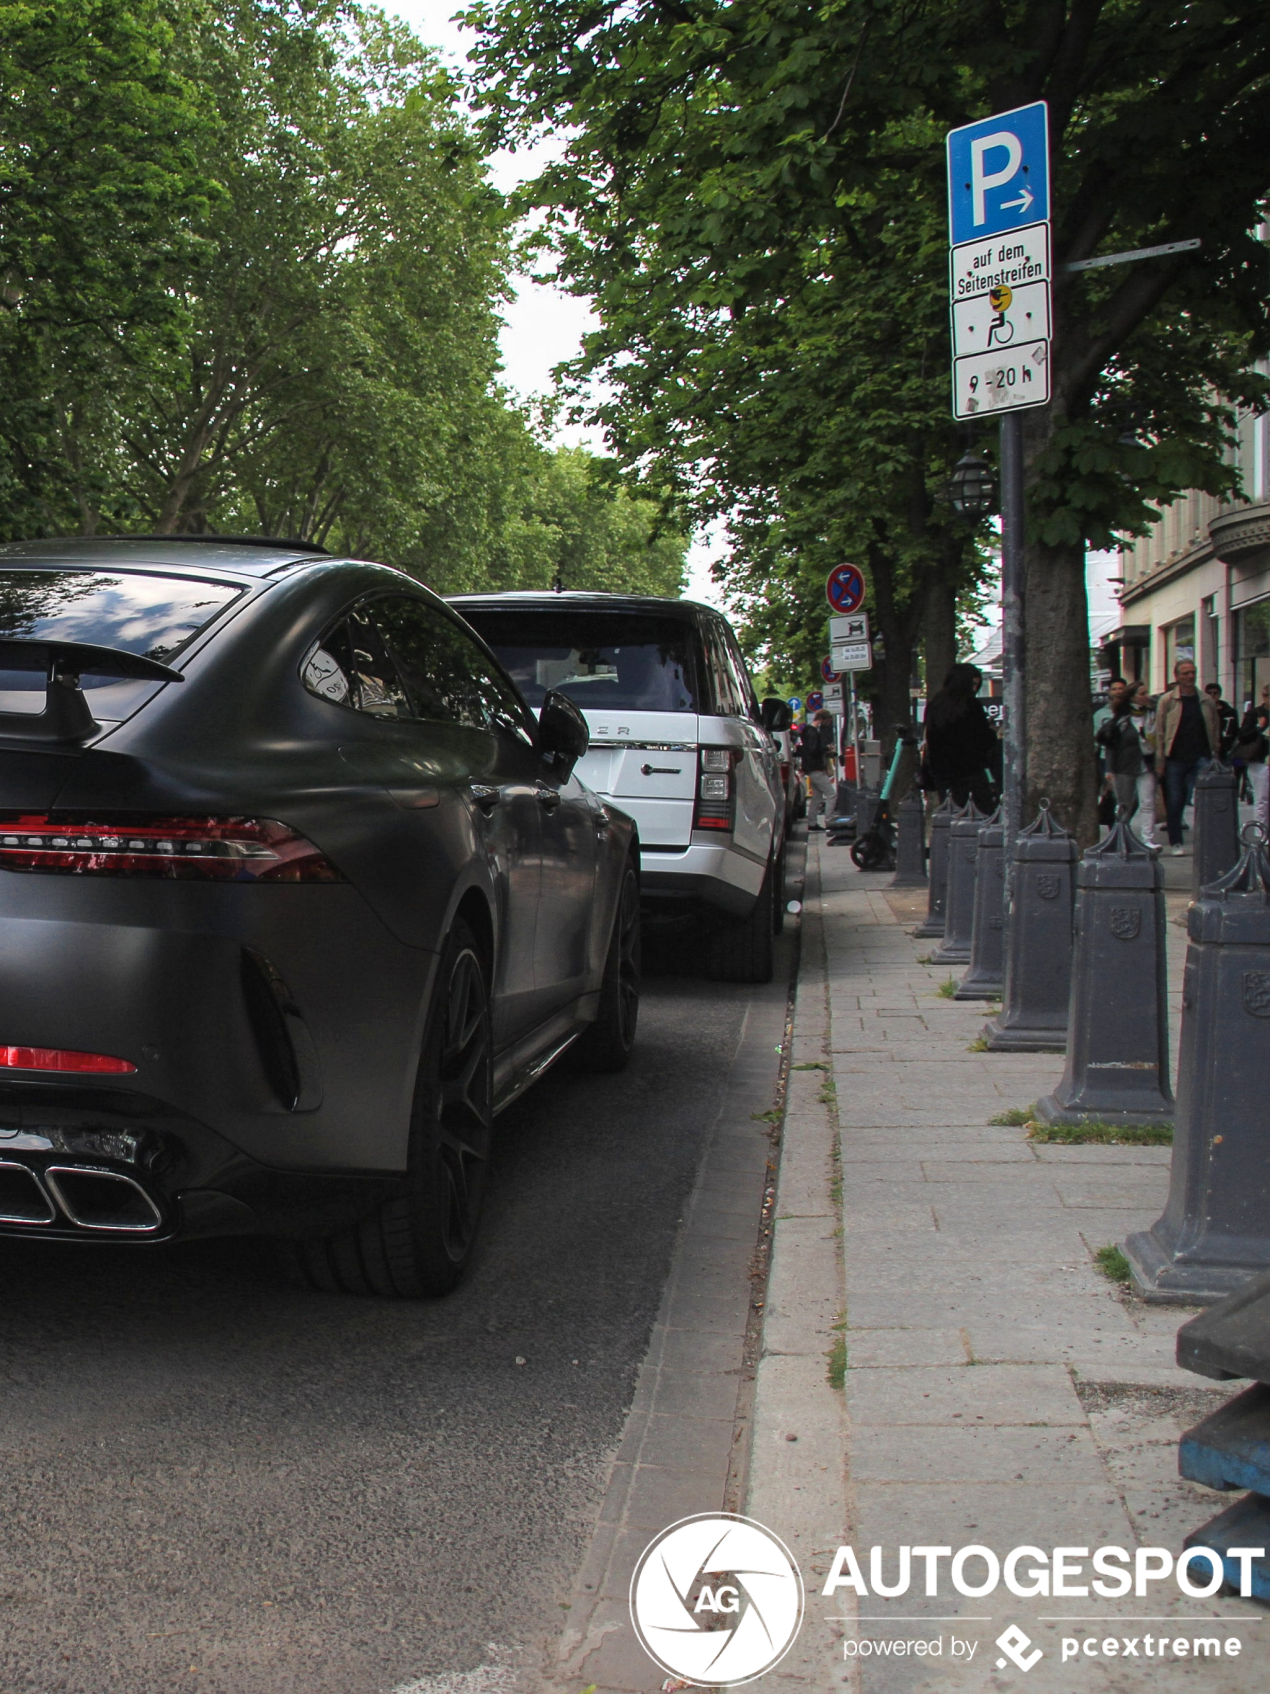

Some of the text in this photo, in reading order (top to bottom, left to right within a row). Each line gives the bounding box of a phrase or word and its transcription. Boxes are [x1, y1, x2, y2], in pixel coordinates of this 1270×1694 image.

[970, 131, 1023, 227] P
[973, 244, 1025, 269] auf dem
[958, 262, 1042, 295] Seitenstreifen
[969, 375, 979, 394] 9
[1022, 364, 1032, 384] h
